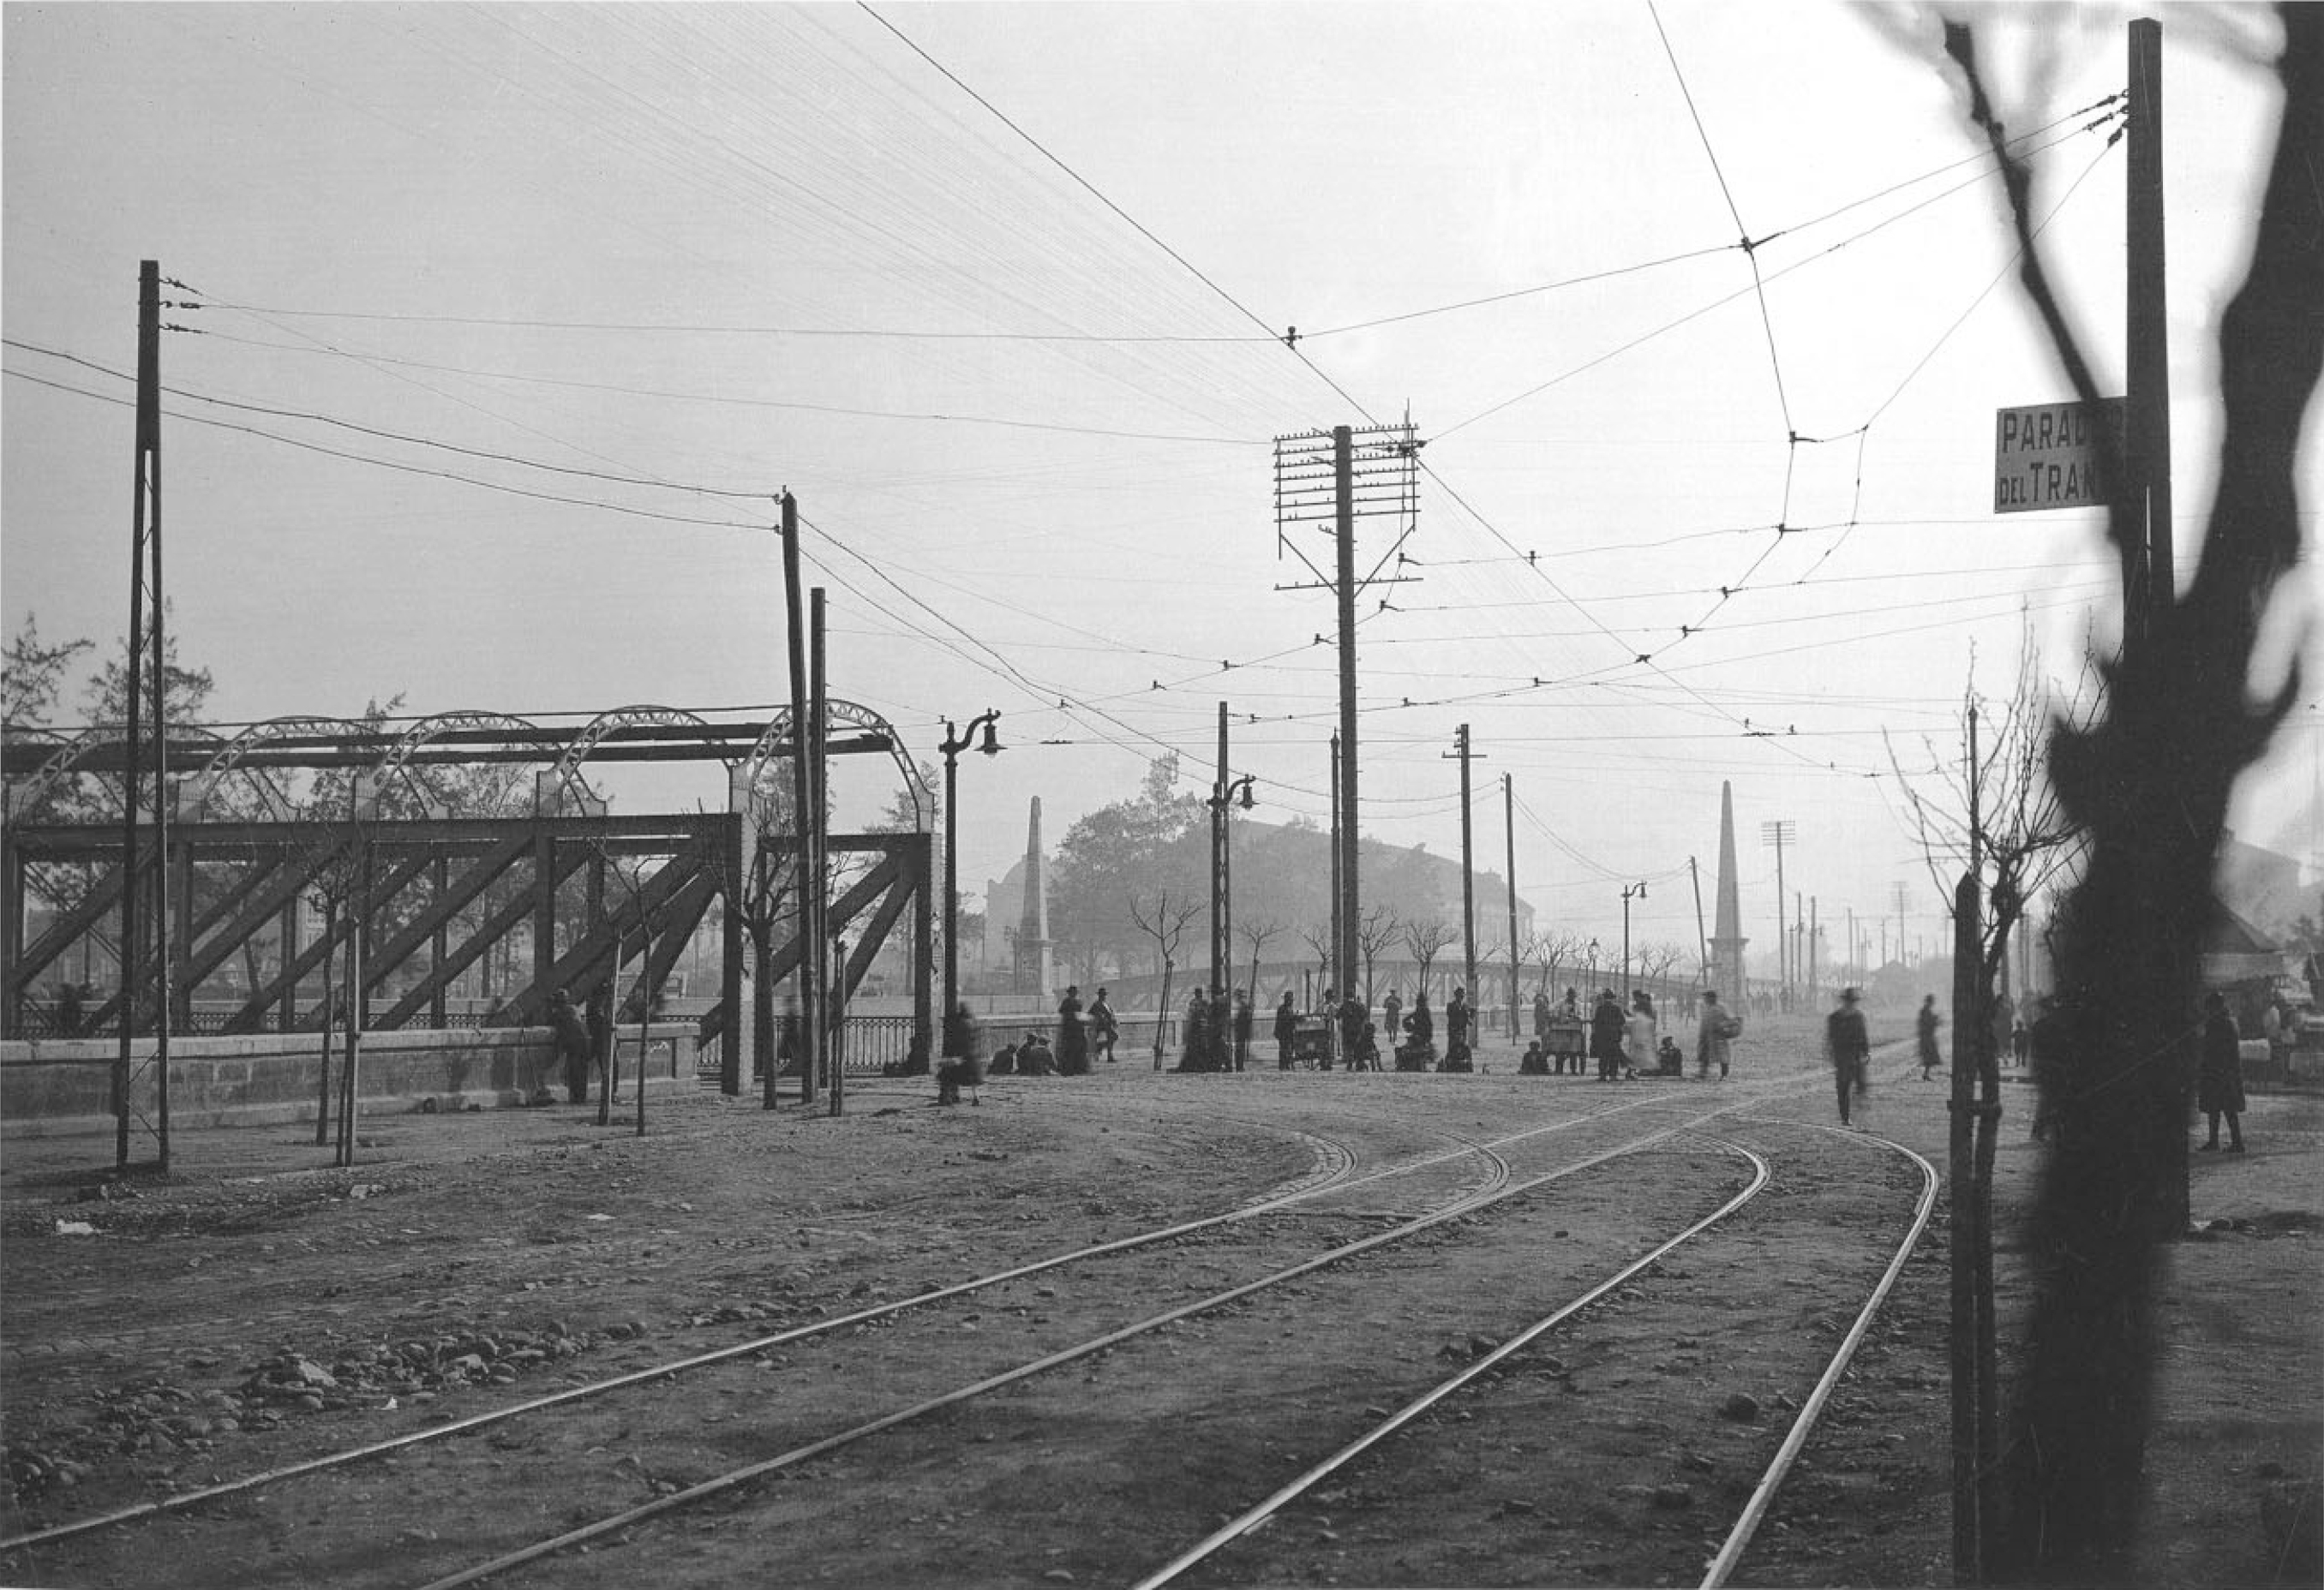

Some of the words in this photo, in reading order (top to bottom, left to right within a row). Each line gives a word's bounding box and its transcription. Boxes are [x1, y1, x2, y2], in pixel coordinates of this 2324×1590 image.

[2003, 406, 2120, 453] PARAD
[1999, 477, 2027, 505] DEL
[2030, 461, 2097, 502] TRAN
